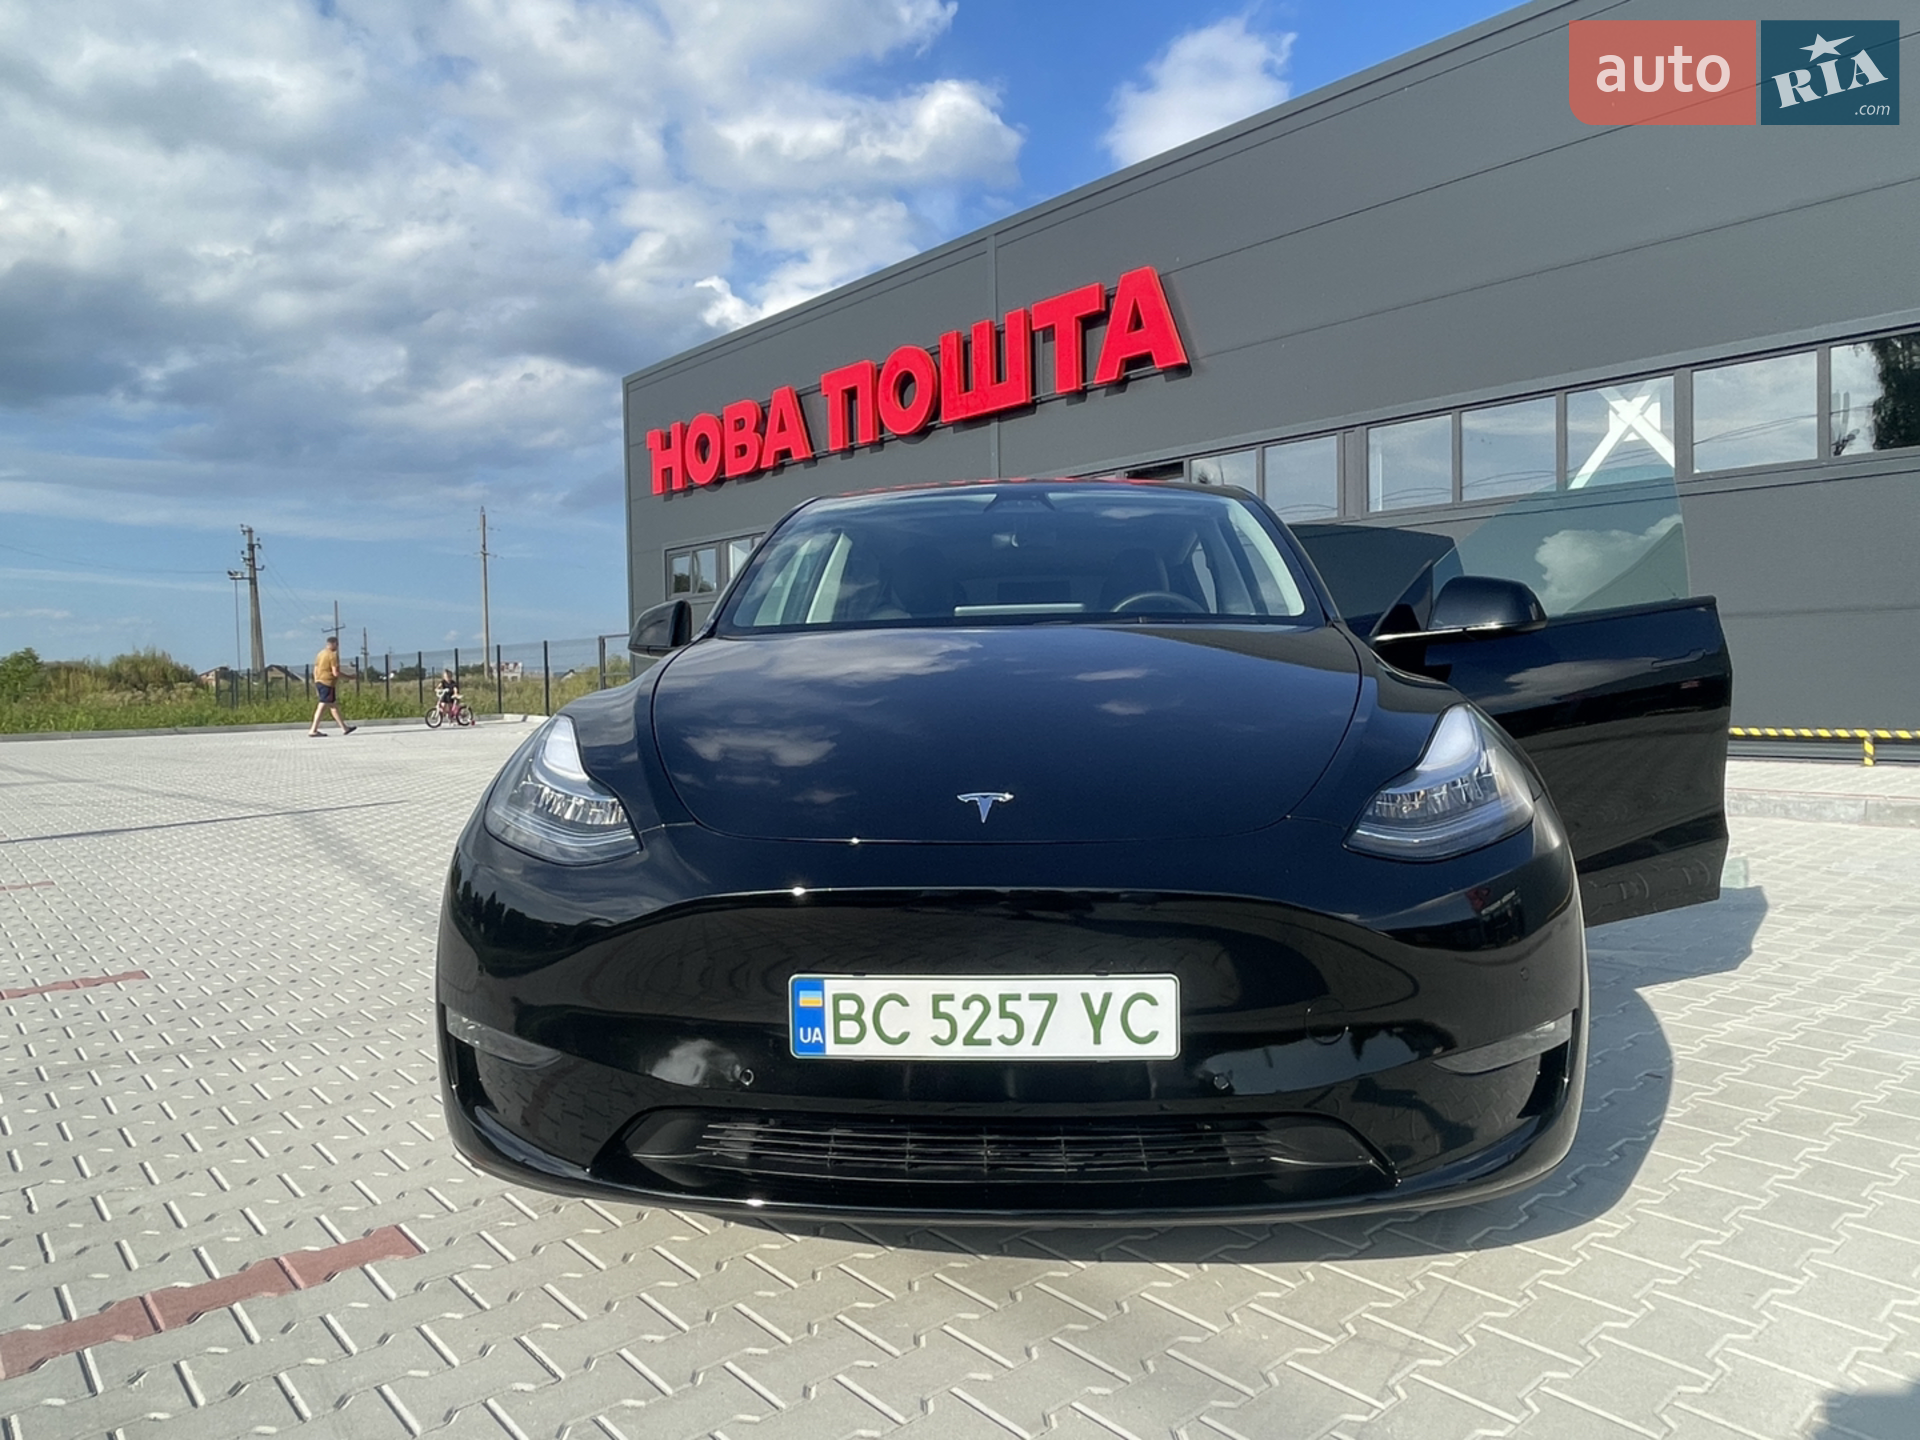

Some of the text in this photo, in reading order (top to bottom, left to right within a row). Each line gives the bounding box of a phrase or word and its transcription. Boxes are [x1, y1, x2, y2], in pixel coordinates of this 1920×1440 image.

[646, 265, 1189, 496] НОВА ПОШТА
[799, 1026, 824, 1044] UA
[832, 991, 1160, 1046] BC 5257 YC
